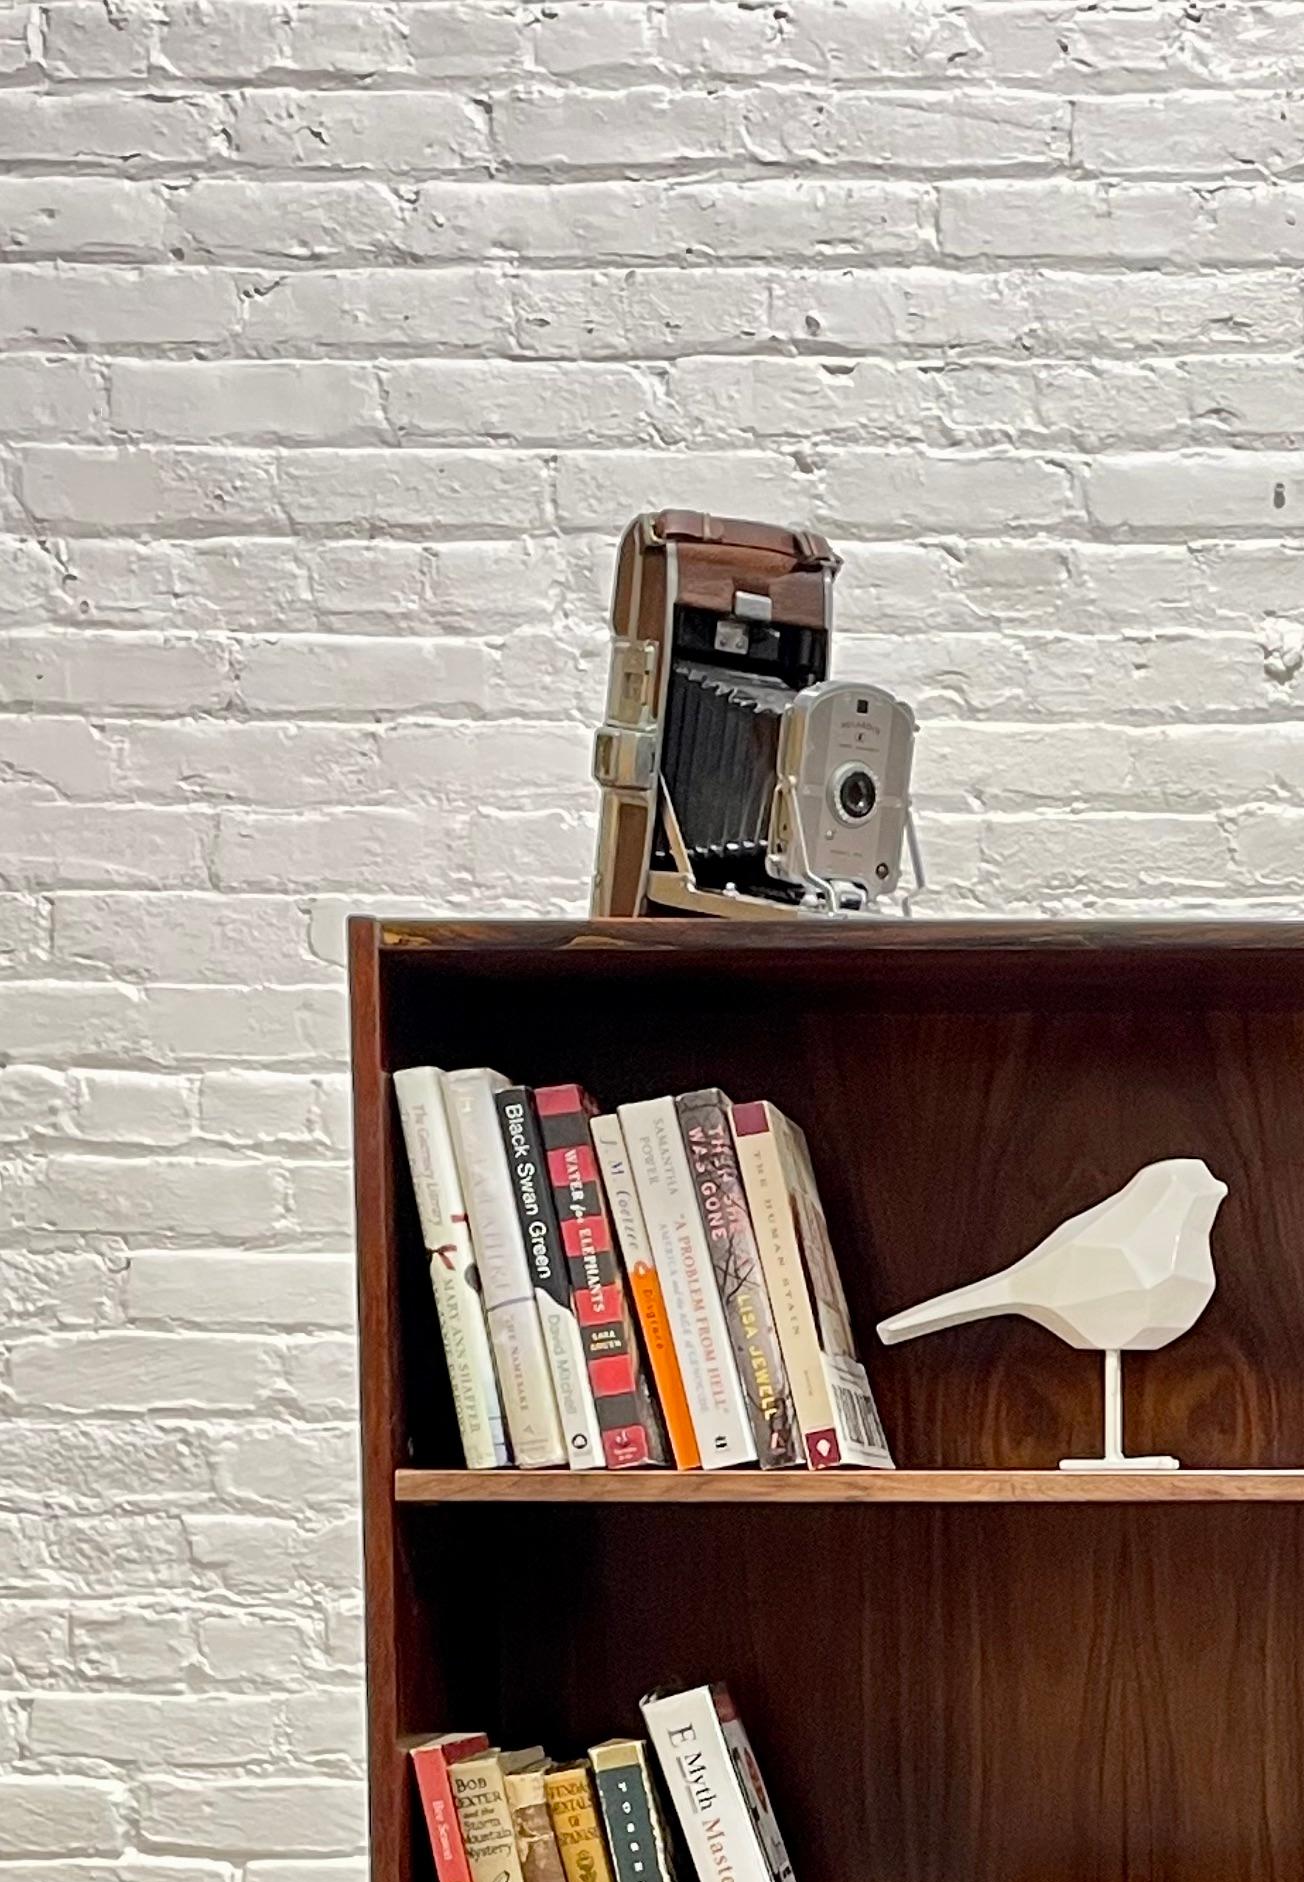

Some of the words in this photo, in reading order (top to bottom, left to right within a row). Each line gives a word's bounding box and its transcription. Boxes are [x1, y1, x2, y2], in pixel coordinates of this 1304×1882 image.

[502, 1102, 533, 1158] Black
[638, 1135, 659, 1185] POWER
[652, 1117, 679, 1195] SAMANTHA
[514, 1161, 541, 1217] Swan
[685, 1126, 710, 1174] WAS
[699, 1180, 726, 1242] GONE
[526, 1221, 555, 1279] Green
[562, 1149, 585, 1201] WATER
[576, 1227, 605, 1313] ELEPHANTS
[763, 1198, 785, 1267] HUMAN
[780, 1277, 800, 1336] STAIN
[442, 1278, 460, 1320] MARY
[677, 1235, 705, 1312] PROBLEM
[695, 1316, 717, 1363] FROM
[451, 1325, 467, 1359] ANN
[545, 1312, 568, 1356] David
[735, 1292, 759, 1339] LISA
[747, 1343, 778, 1421] JEWELL
[457, 1362, 481, 1434] SHAFFER
[508, 1346, 529, 1411] NAMESAKE
[553, 1357, 582, 1415] Mitchell
[666, 1722, 697, 1749] E
[676, 1749, 719, 1814] Myth
